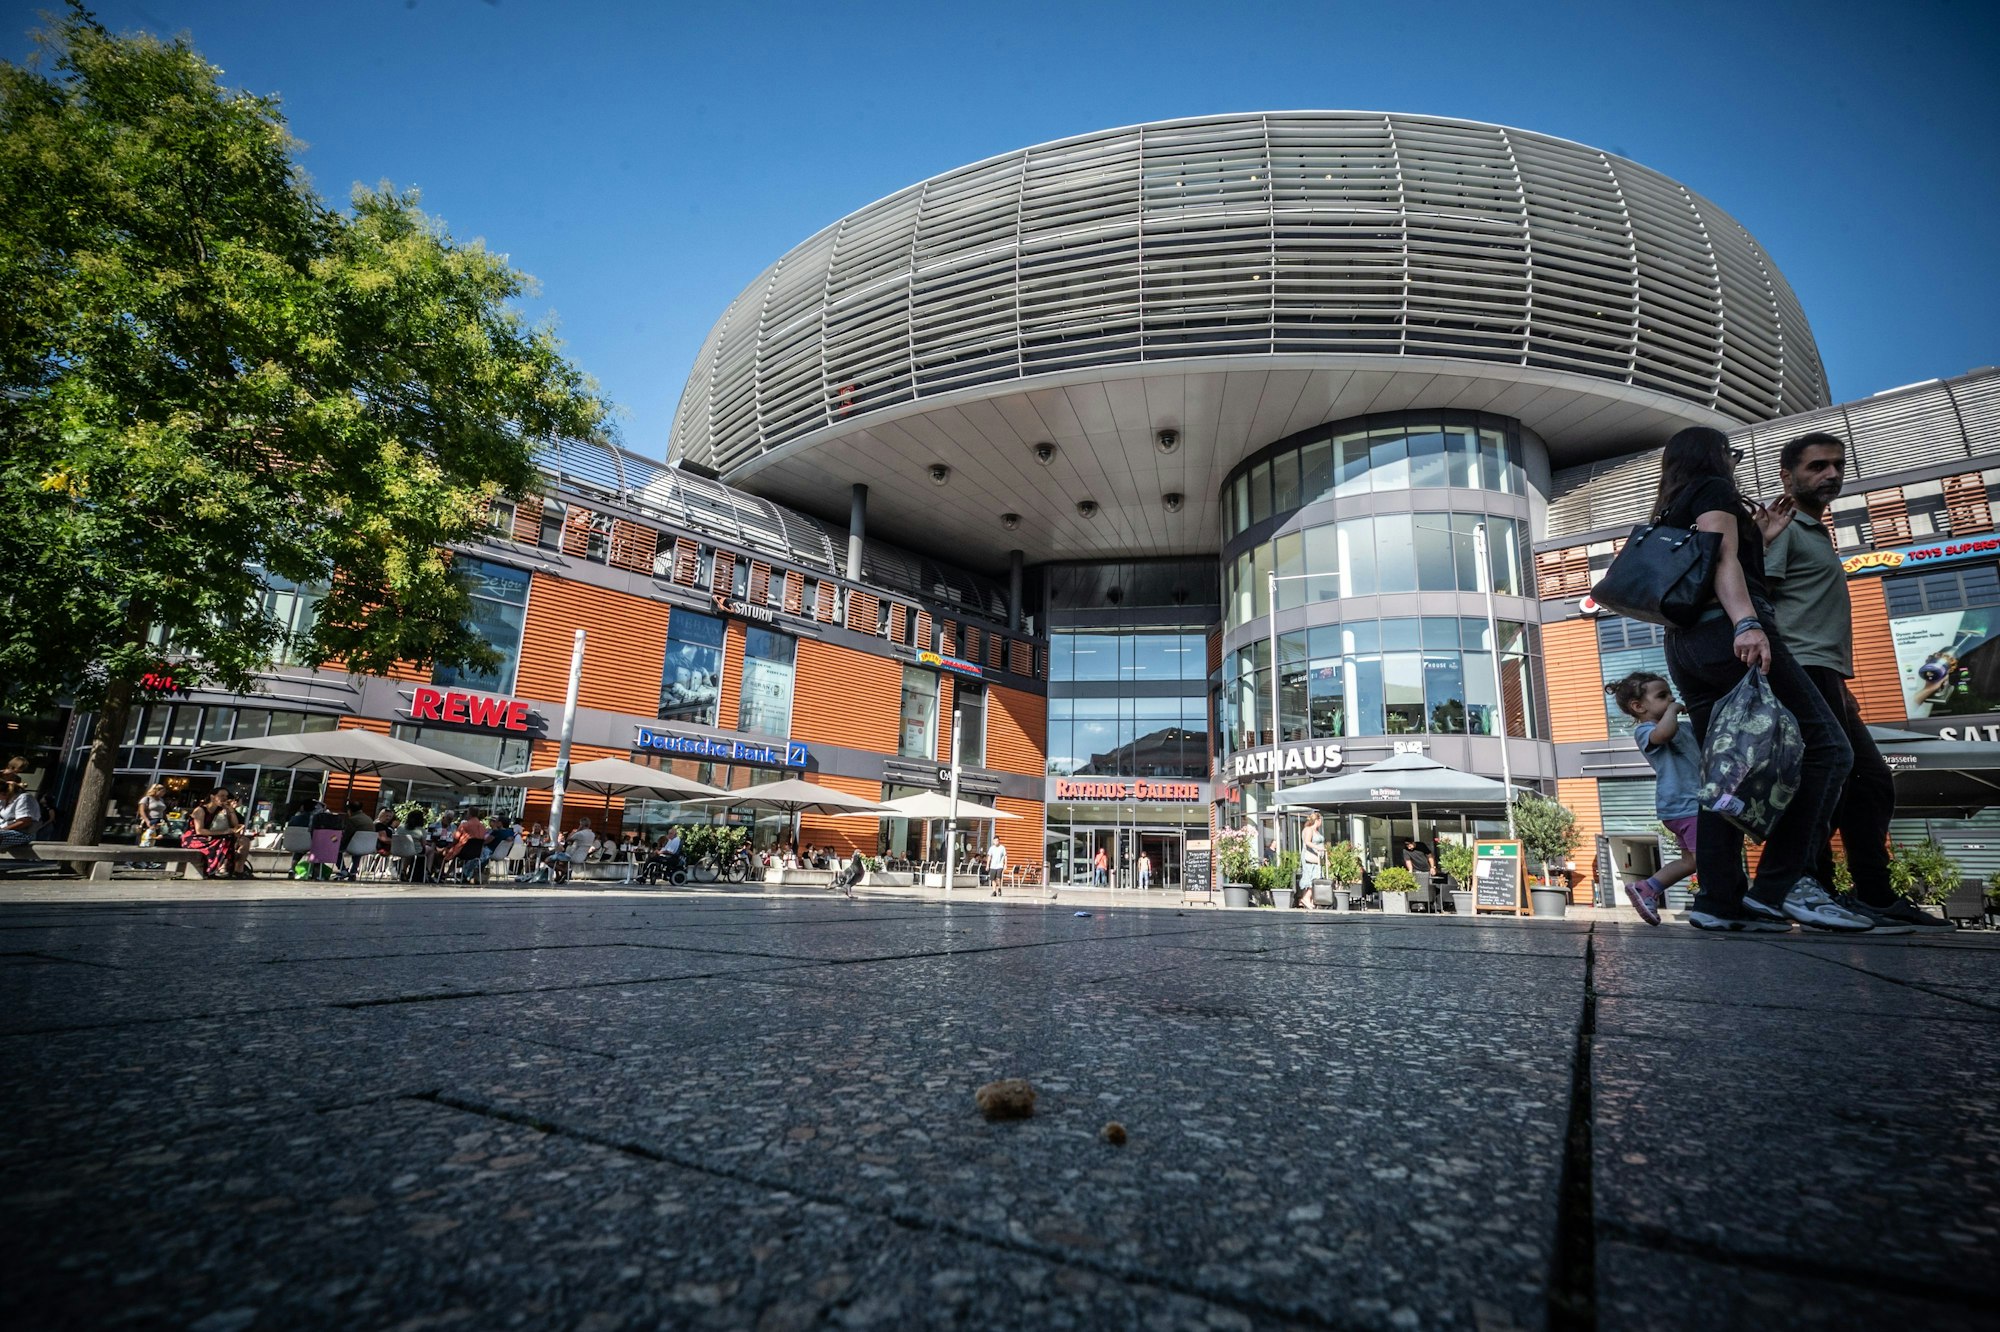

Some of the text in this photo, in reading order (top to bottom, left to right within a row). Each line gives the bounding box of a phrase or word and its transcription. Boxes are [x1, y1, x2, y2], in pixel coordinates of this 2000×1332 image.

[1843, 553, 1903, 571] SMYTHS
[1908, 547, 1942, 562] TOYS
[735, 602, 773, 623] SATURN
[411, 688, 529, 731] REWE
[638, 727, 776, 764] Deutsche Bank
[1235, 744, 1343, 777] RATHAUS
[1056, 779, 1199, 799] RATHAUS-GALERIE
